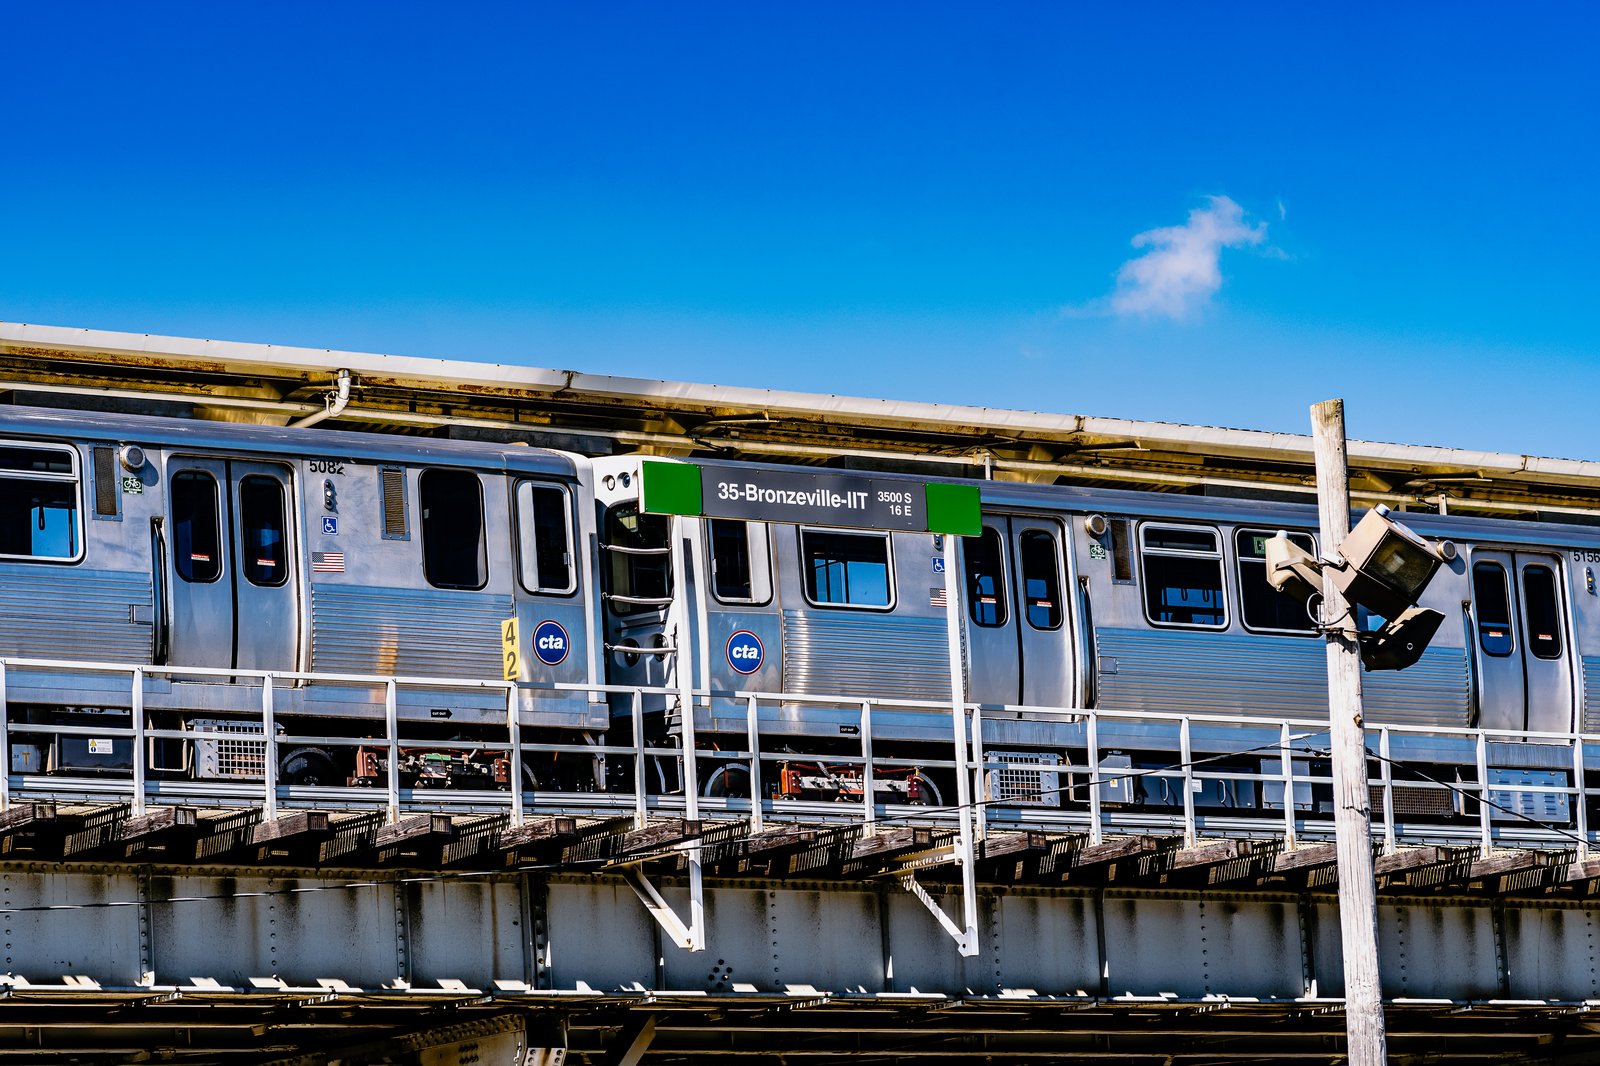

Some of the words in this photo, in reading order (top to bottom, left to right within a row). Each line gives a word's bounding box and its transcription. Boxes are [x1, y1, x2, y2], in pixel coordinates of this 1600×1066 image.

[309, 460, 345, 475] 5082
[717, 481, 868, 510] 35-Bronzeville-IIT
[877, 490, 903, 503] 3500
[904, 492, 912, 504] S
[889, 504, 902, 516] 16
[904, 505, 912, 517] E
[1573, 550, 1600, 563] 5156
